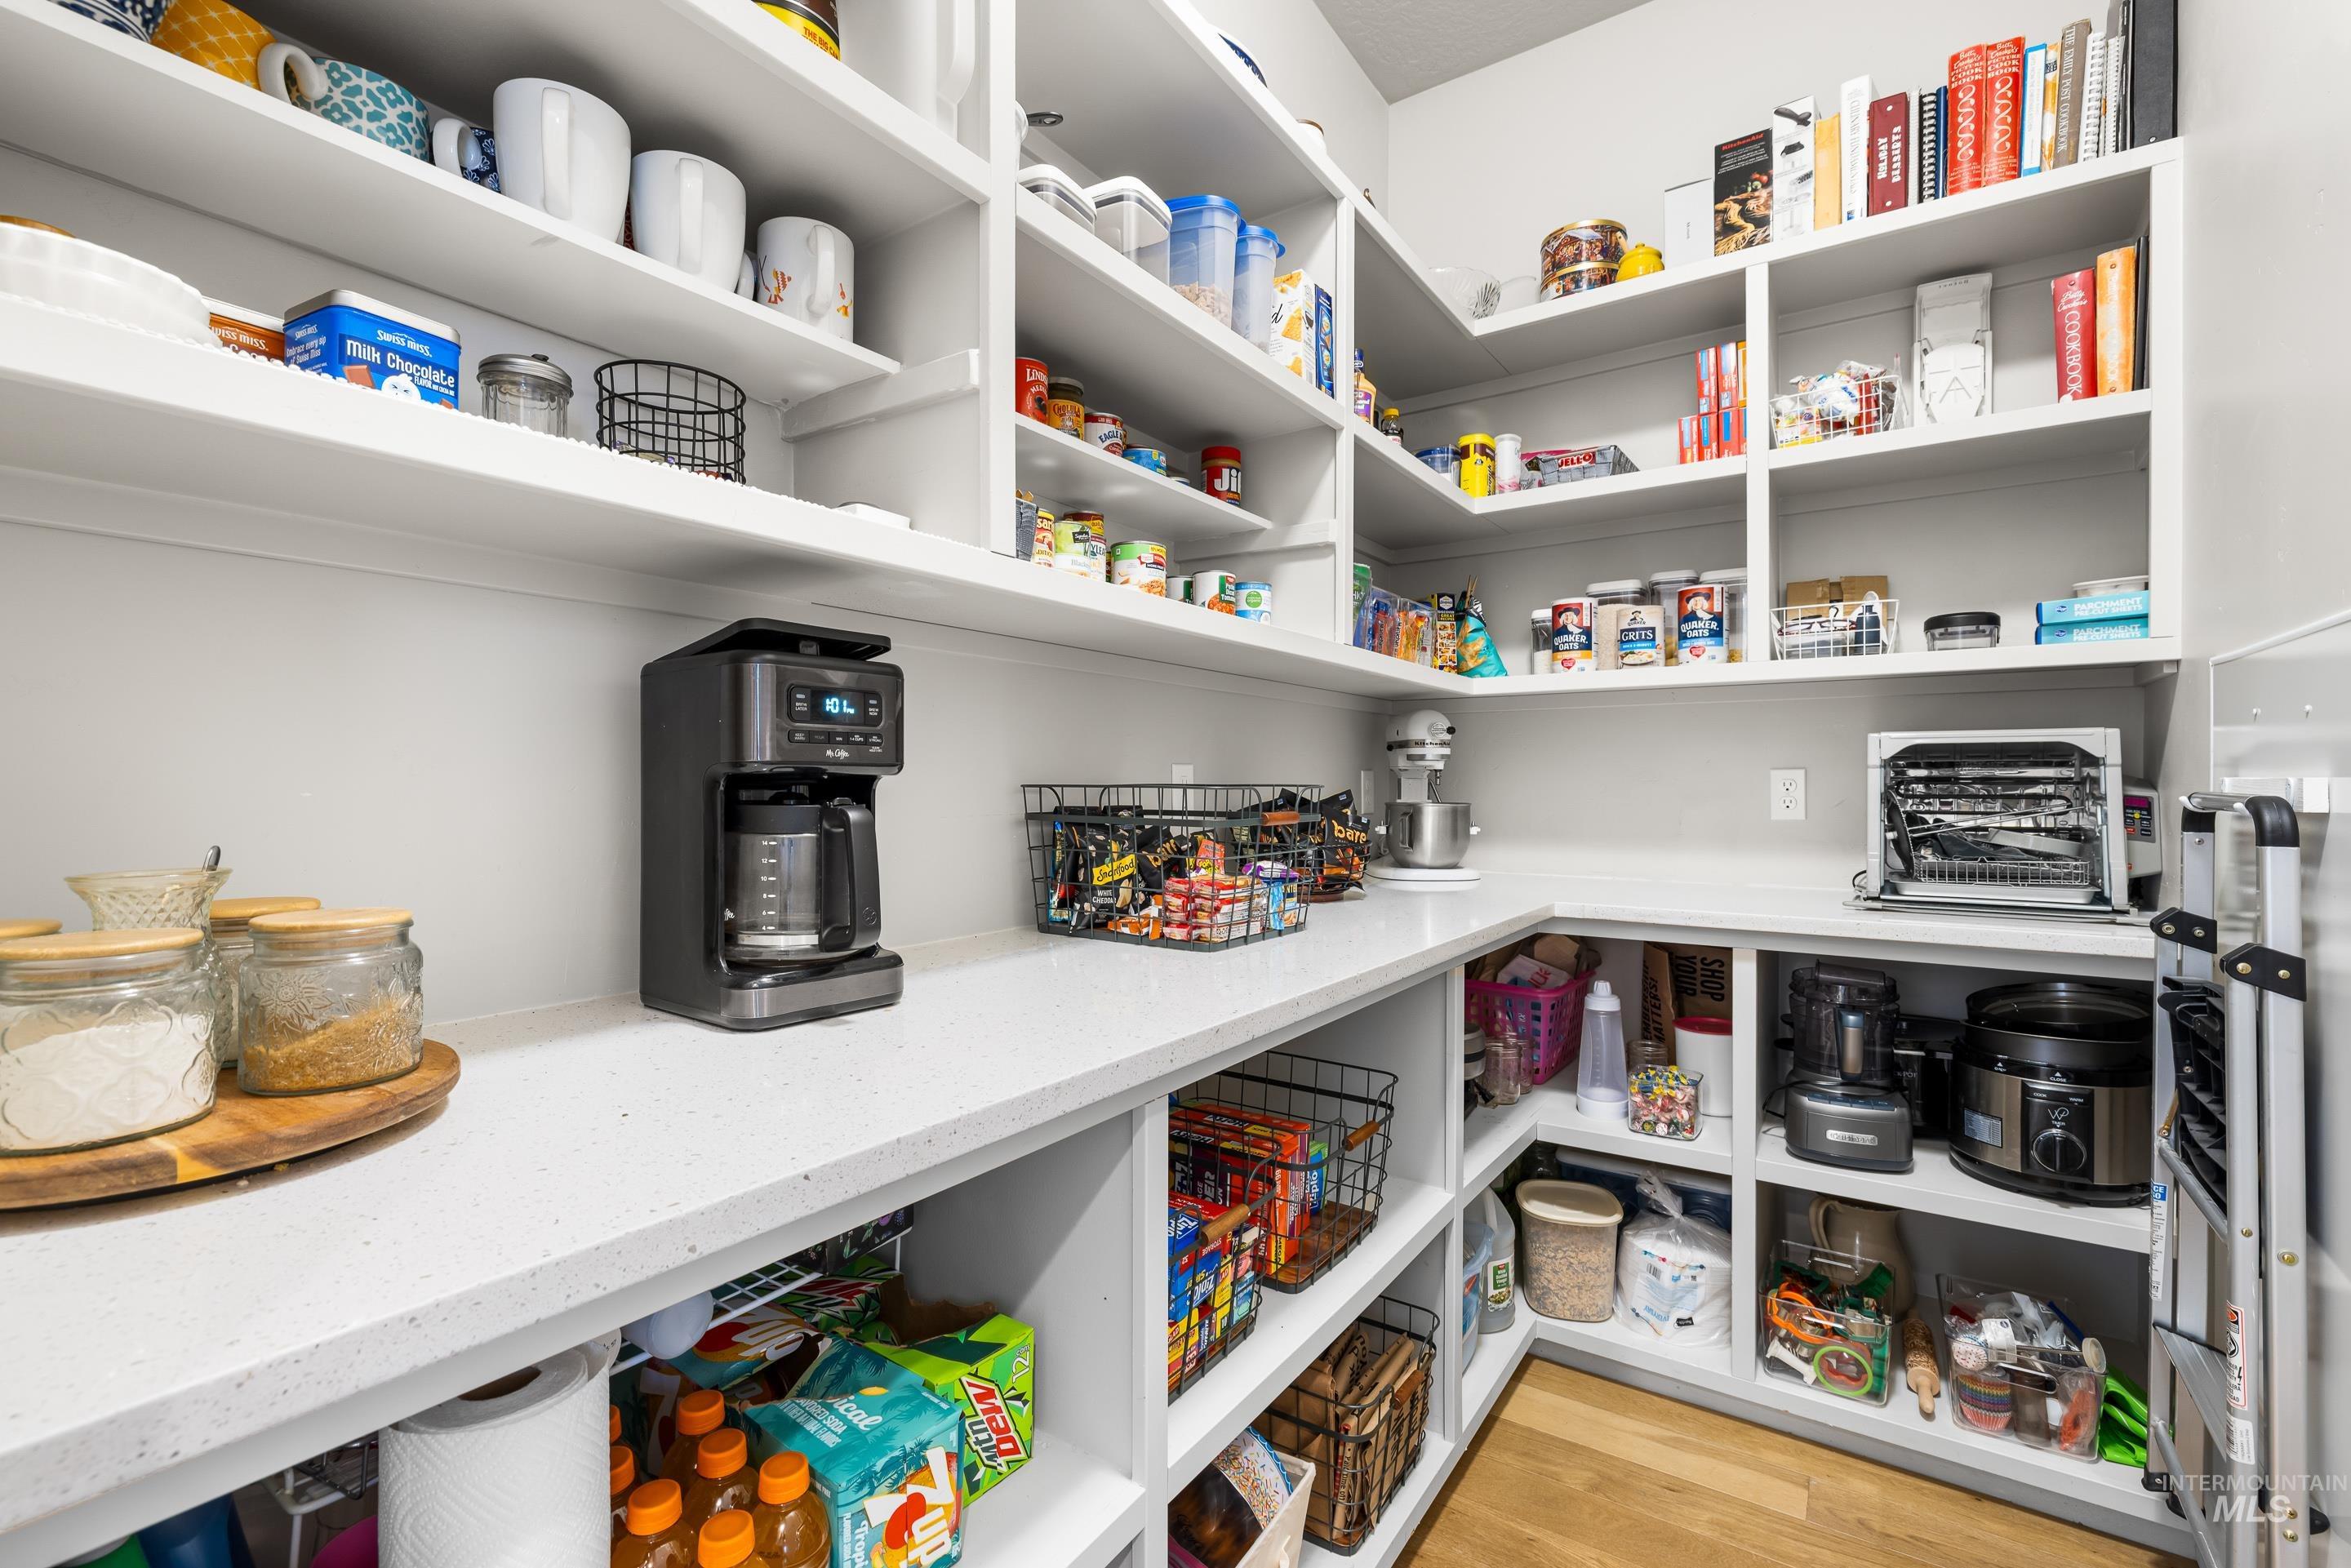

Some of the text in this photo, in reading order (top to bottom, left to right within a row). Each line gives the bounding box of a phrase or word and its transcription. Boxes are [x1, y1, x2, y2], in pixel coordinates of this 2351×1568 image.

[803, 27, 817, 41] THE
[818, 36, 829, 50] BIG
[1997, 41, 2014, 51] Betty
[1959, 48, 1976, 60] Betty
[1987, 54, 2020, 65] PICTURE
[1951, 61, 1984, 75] PICTURE
[1987, 60, 2020, 72] COOK
[1987, 66, 2020, 79] BOOK
[1951, 67, 1984, 82] COOK
[1951, 73, 1984, 89] BOOK
[2057, 26, 2076, 153] THE EMILY POST COOKBOOK
[1722, 132, 1764, 151] KitchenAid
[1877, 137, 1888, 180] HOLIDAY
[1891, 125, 1902, 183] DESSERTS
[2061, 289, 2085, 304] Betty
[2057, 299, 2088, 312] Crocker's
[305, 339, 318, 353] every
[318, 335, 327, 348] sip
[296, 351, 309, 365] Swiss
[309, 349, 321, 360] Miss
[2064, 311, 2082, 397] COOKBOOK
[346, 340, 455, 388] Milk Chocolate
[414, 375, 433, 389] FLAVOR
[1053, 403, 1082, 417] CHOLULA
[1098, 429, 1119, 444] EAGLE
[1558, 452, 1594, 468] JELL-O
[2074, 597, 2142, 611] PARCHMENT
[2075, 604, 2142, 617] PRE-CUT SHEETS
[1681, 620, 1719, 633] QUAKER
[1687, 629, 1709, 638] OATS
[2073, 624, 2140, 636] PARCHMENT
[1553, 634, 1589, 646] QUAKER
[1621, 629, 1653, 641] GRITS
[2073, 631, 2141, 642] PRE-CUT SHEETS
[825, 697, 847, 713] 1:01
[834, 748, 850, 760] Coffee
[1332, 820, 1367, 843] bare
[1097, 860, 1135, 882] Smartfood
[724, 908, 735, 921] ffee
[1675, 955, 1697, 997] YOUR
[1700, 957, 1725, 1002] SHOP
[1202, 1237, 1222, 1255] STORAGE
[1219, 1268, 1229, 1283] LAD
[1016, 1344, 1030, 1357] cans
[1012, 1351, 1030, 1383] 12
[831, 1395, 883, 1431] ical
[795, 1413, 821, 1435] NATURAL
[813, 1424, 842, 1448] FLAVORS
[824, 1415, 848, 1435] SODA
[854, 1521, 869, 1568] Tropi
